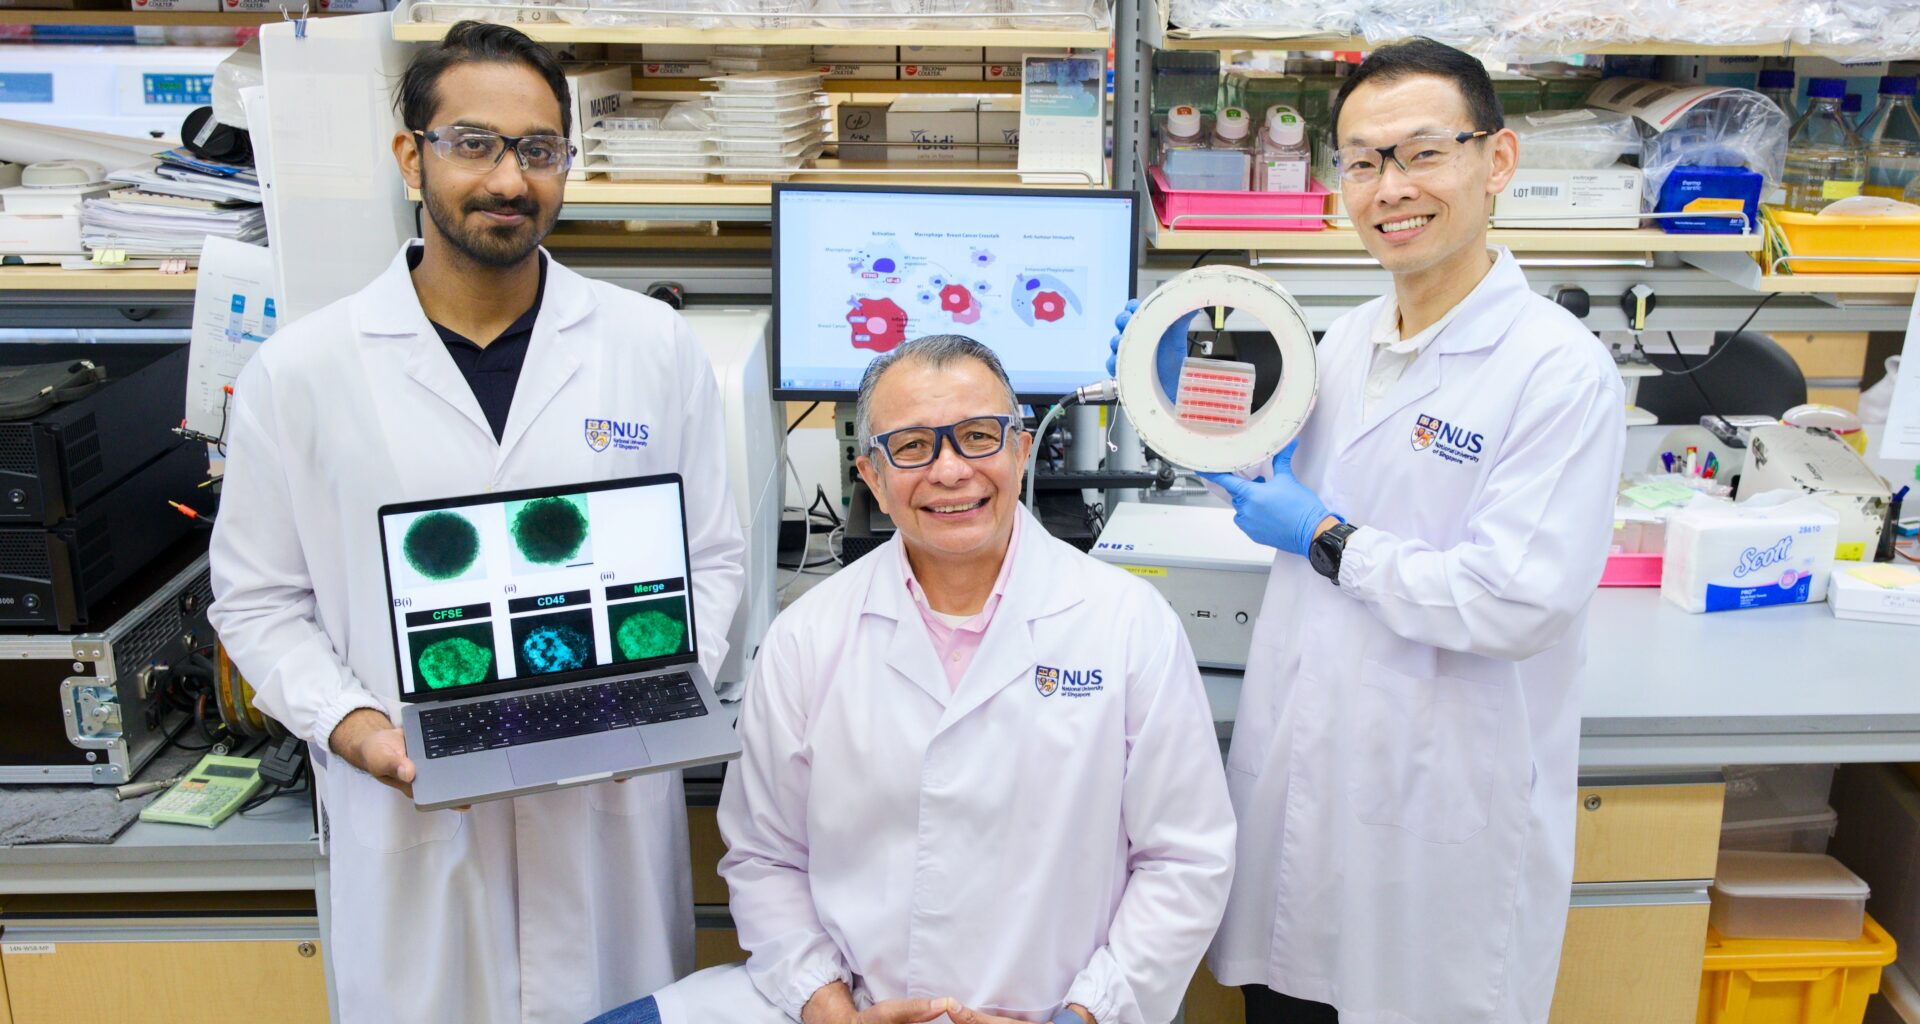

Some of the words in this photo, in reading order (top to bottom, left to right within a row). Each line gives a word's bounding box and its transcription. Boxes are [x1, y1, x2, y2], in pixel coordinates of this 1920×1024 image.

[590, 93, 621, 117] MAXITEX
[1513, 188, 1529, 198] LOT
[613, 421, 650, 440] NUS
[1439, 422, 1484, 454] NUS
[1098, 542, 1135, 551] NUS
[1733, 535, 1793, 578] Scott
[600, 571, 616, 581] (iii)
[504, 584, 517, 594] (ii)
[633, 581, 665, 594] Merge
[537, 594, 566, 607] CD45
[432, 607, 463, 621] CFSE
[1062, 669, 1103, 686] NUS
